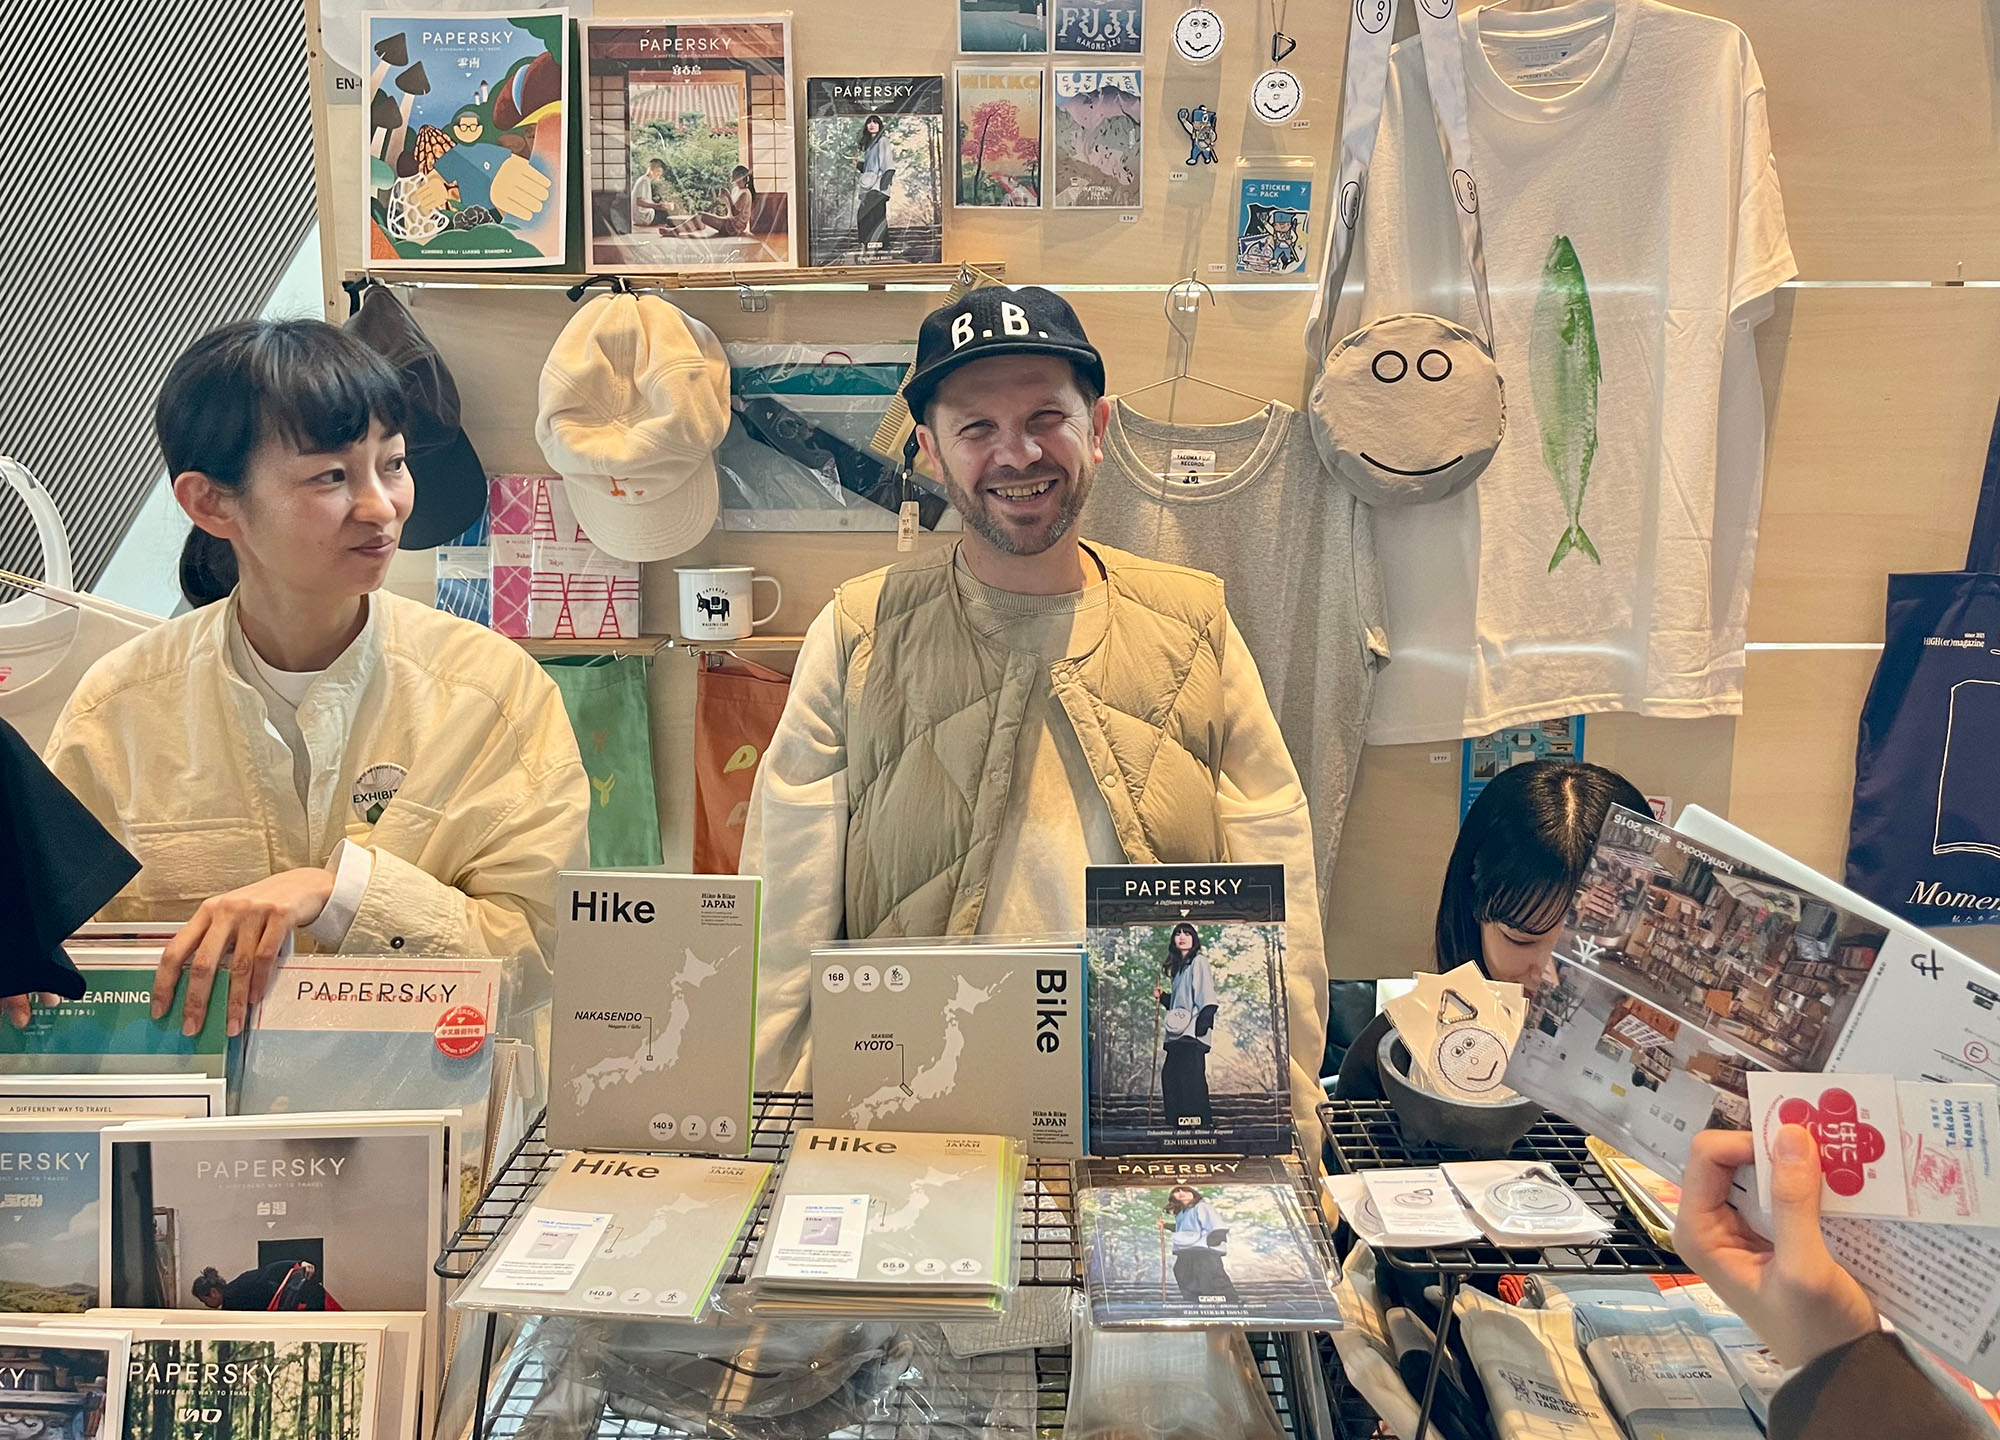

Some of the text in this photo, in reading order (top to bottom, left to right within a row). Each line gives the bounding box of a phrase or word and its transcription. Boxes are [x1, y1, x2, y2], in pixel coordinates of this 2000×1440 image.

[1057, 8, 1140, 38] FUJI
[422, 31, 513, 45] PAPERSKY
[640, 38, 732, 51] PAPERSKY
[960, 74, 1040, 89] NIKKO
[834, 86, 913, 97] PAPERSKY
[1260, 184, 1291, 192] STICKER
[1613, 813, 1735, 875] honkbooks since 2016
[1125, 878, 1243, 896] PAPERSKY
[572, 890, 656, 924] Hike
[701, 899, 736, 909] JAPAN
[828, 973, 844, 981] 168
[863, 972, 870, 981] 3
[297, 981, 458, 1003] PAPERSKY
[574, 1011, 642, 1021] NAKASENDO
[1036, 969, 1067, 1053] Bike
[854, 1040, 894, 1051] KYOTO
[653, 1121, 674, 1130] 140.9
[691, 1122, 696, 1130] 7
[1032, 1118, 1067, 1127] JAPAN
[809, 1136, 897, 1154] Hike
[0, 1152, 90, 1171] ERSKY
[197, 1157, 346, 1178] PAPERSKY
[571, 1158, 660, 1179] Hike
[709, 1168, 744, 1176] JAPAN
[1118, 1163, 1240, 1174] PAPERSKY
[589, 1289, 612, 1297] 140.9
[128, 1361, 280, 1385] PAPERSKY
[1680, 1371, 1712, 1380] SOCKS
[1533, 1390, 1582, 1410] TWO-TOE
[1537, 1400, 1600, 1420] TABI SOCKS
